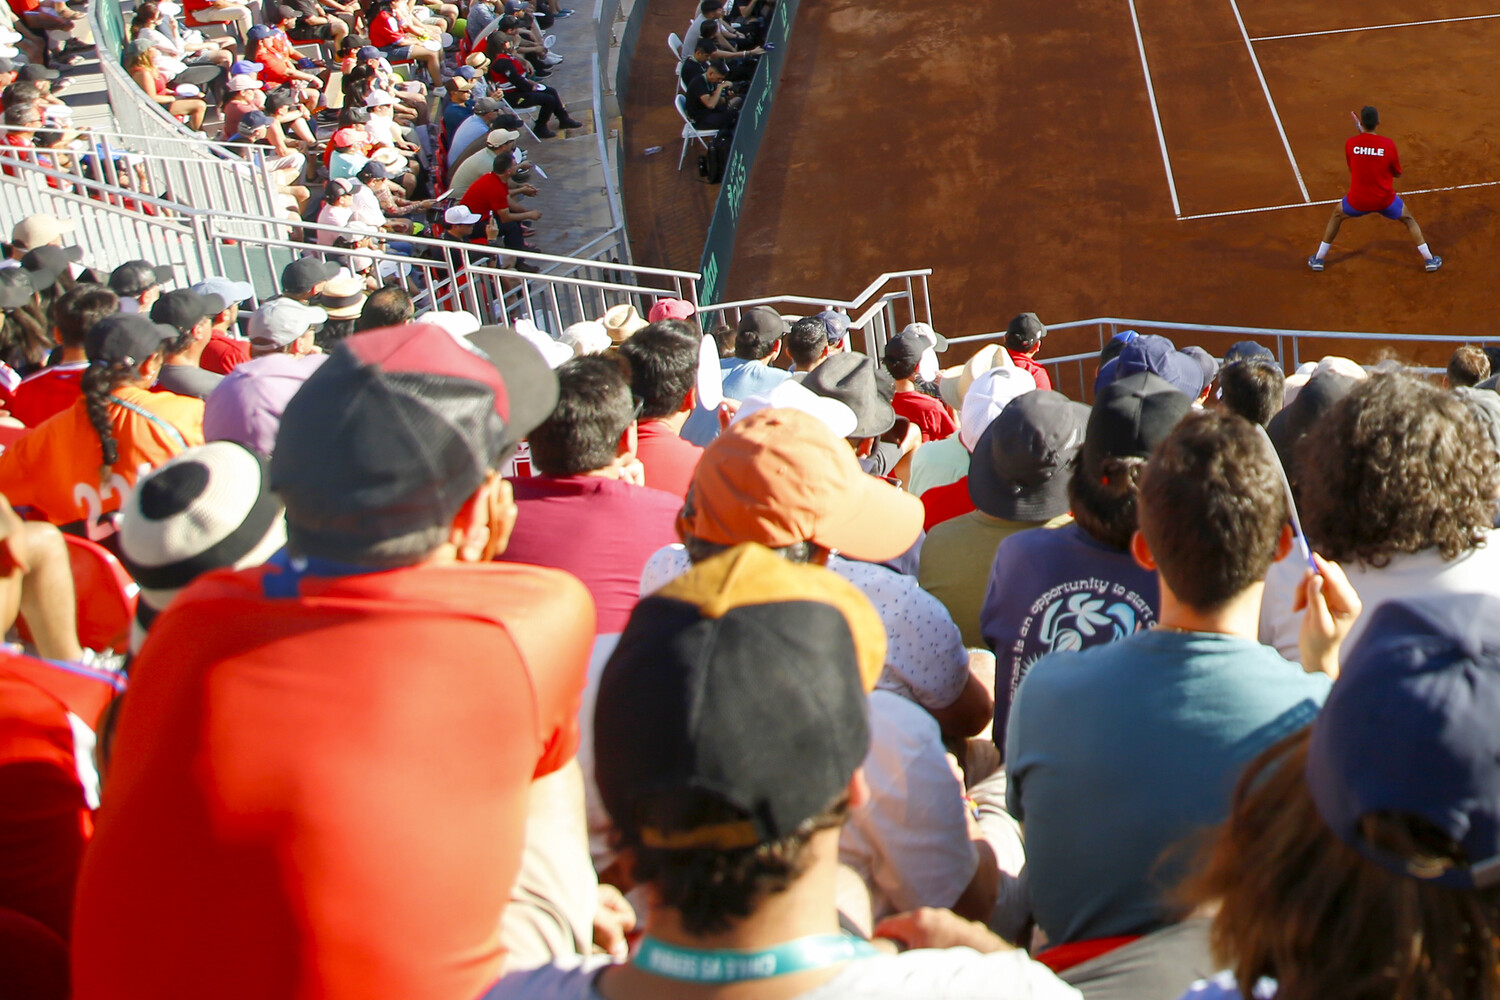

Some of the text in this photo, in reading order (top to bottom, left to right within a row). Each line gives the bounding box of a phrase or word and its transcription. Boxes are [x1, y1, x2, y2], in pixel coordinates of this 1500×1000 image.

[1353, 146, 1384, 157] CHILE
[1013, 639, 1024, 652] is
[1021, 616, 1033, 637] an
[1031, 577, 1110, 615] opportunity
[1113, 583, 1126, 596] to
[1126, 592, 1154, 619] start
